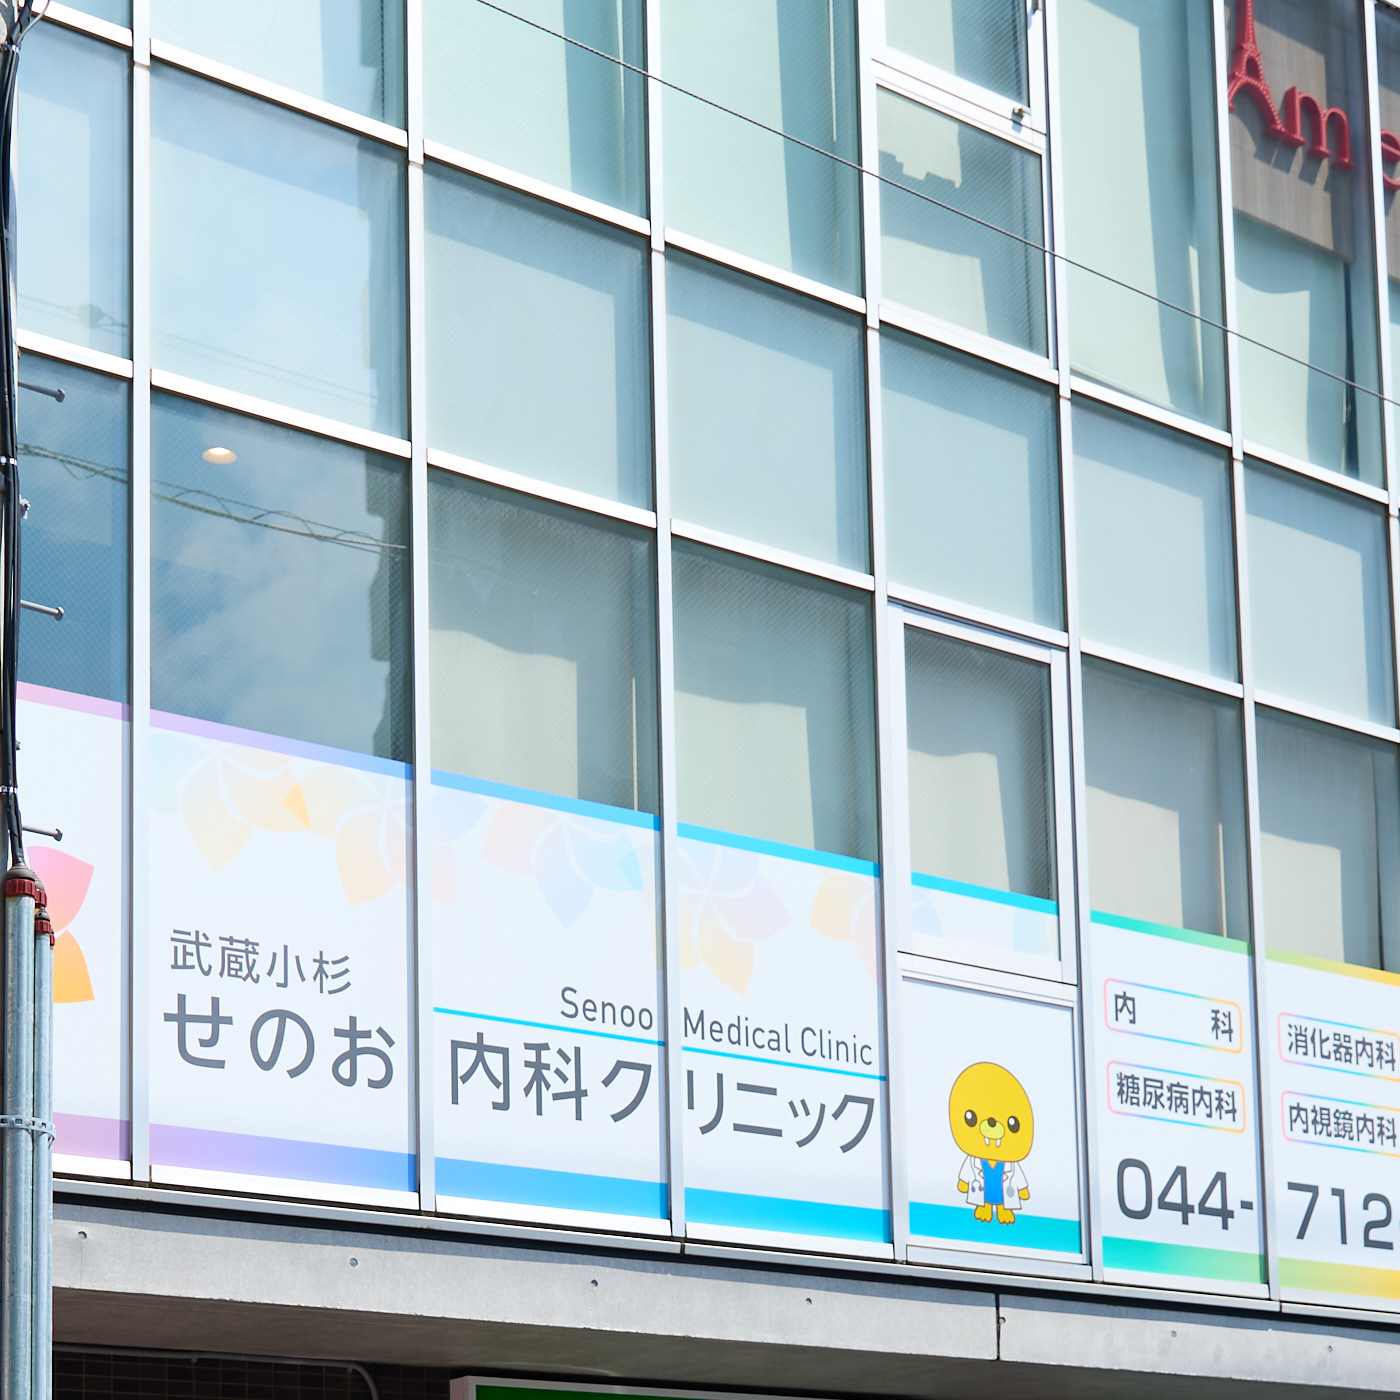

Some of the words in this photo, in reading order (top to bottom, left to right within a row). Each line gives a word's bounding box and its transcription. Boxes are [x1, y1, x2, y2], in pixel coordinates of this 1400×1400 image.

[168, 928, 352, 995] 武蔵小杉
[560, 986, 655, 1033] Senoo
[683, 1006, 792, 1056] Medical
[800, 1022, 874, 1067] Clinic
[1113, 990, 1235, 1044] 内科
[162, 992, 876, 1156] せのお内科クリニック
[1286, 1021, 1397, 1073] 消化器内科
[1115, 1071, 1238, 1125] 糖尿病内科
[1287, 1100, 1398, 1149] 内視鏡内科
